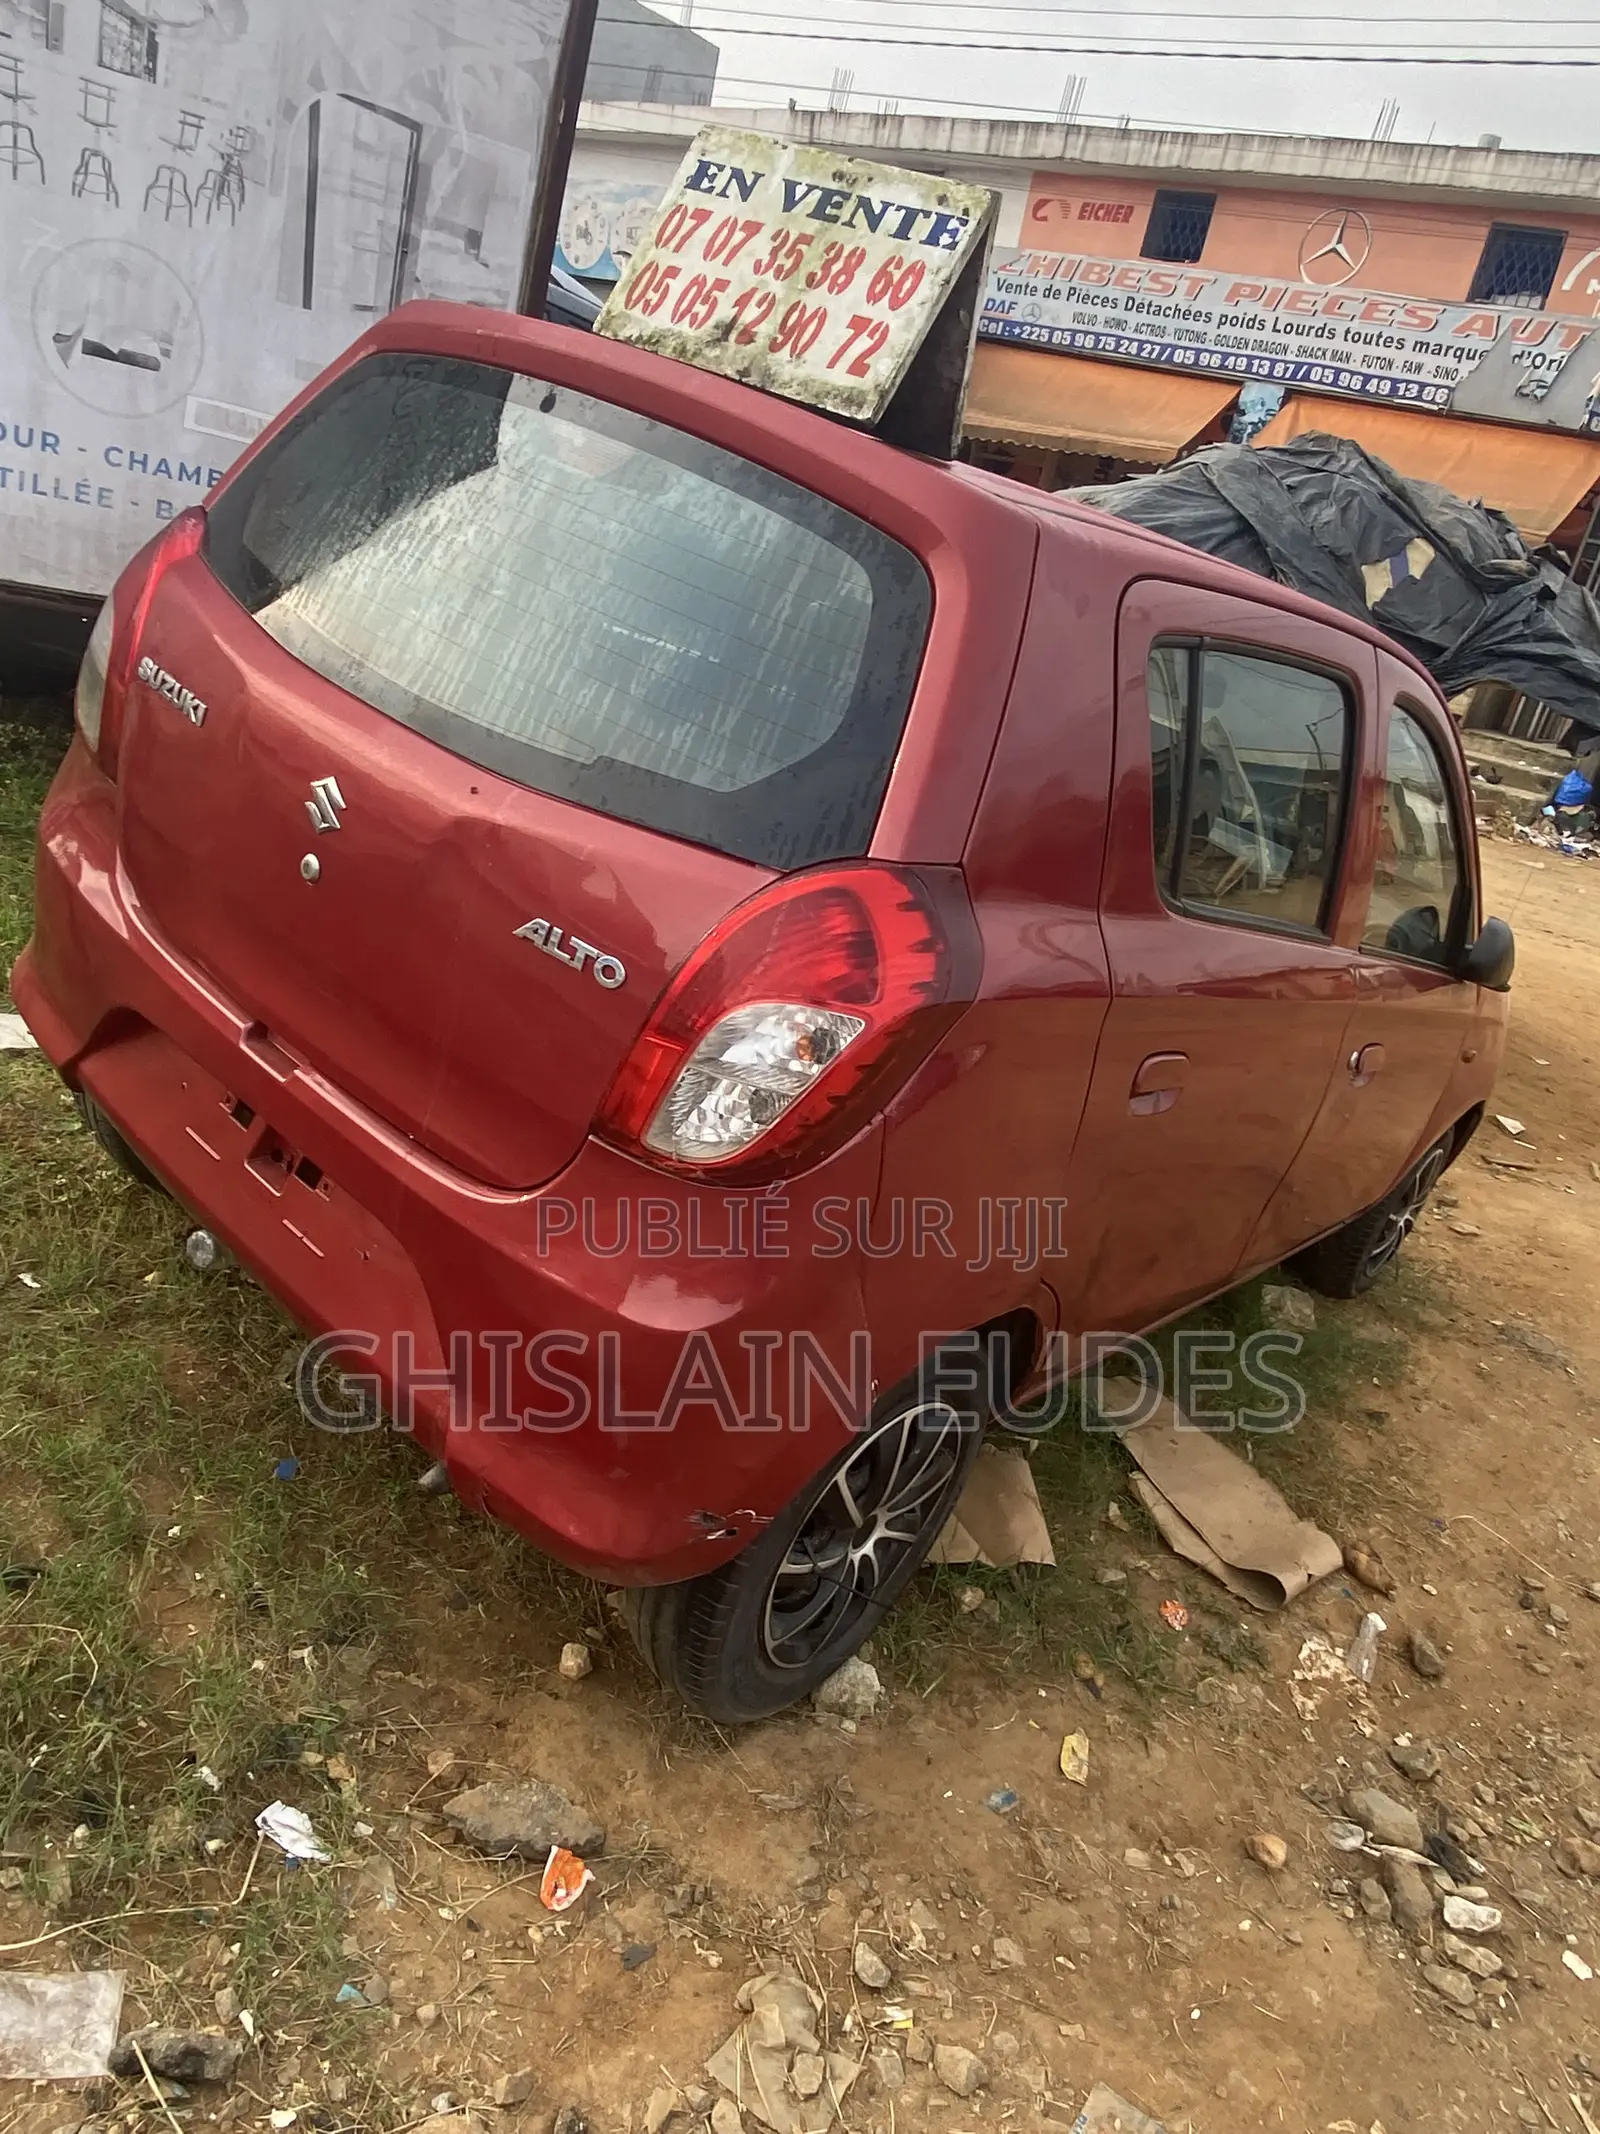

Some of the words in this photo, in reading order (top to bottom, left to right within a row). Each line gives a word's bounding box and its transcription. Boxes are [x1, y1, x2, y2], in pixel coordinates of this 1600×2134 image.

[683, 158, 766, 203] EN
[781, 178, 970, 252] VENTE
[1077, 201, 1135, 225] EICHER
[655, 204, 714, 254] 07
[703, 215, 766, 267] 07
[753, 228, 816, 282] 35
[805, 241, 867, 296] 38
[866, 255, 927, 312] 60
[624, 260, 684, 317] 05
[671, 273, 732, 331] 05
[730, 286, 777, 346] 12
[768, 299, 828, 359] 90
[826, 314, 891, 379] 72
[984, 298, 1019, 315] DAF
[996, 277, 1038, 297] Vente
[1042, 283, 1062, 300] de
[1066, 286, 1119, 311] Pièces
[1124, 295, 1213, 324] Détachées
[1217, 312, 1267, 332] poids
[1271, 317, 1337, 340] Lourds
[1343, 326, 1407, 350] toutes
[1223, 281, 1446, 333] PIECES
[1052, 331, 1072, 345] 05
[1074, 333, 1096, 348] 96
[1098, 336, 1117, 351] 75
[1118, 339, 1139, 355] 24
[1140, 344, 1161, 359] 27
[1173, 348, 1196, 364] 05
[1224, 356, 1248, 371] 49
[1251, 359, 1271, 375] 13
[1309, 366, 1336, 384] 05
[1365, 376, 1392, 395] 49
[1395, 381, 1420, 398] 13
[1072, 311, 1098, 327] VOLVO
[1132, 322, 1167, 339] ACTROS
[1173, 328, 1208, 344] YUTONG
[1214, 334, 1250, 350] GOLDEN
[1251, 340, 1290, 357] DRAGON
[1295, 345, 1328, 361] SHACK
[1329, 349, 1352, 365] MAN
[1360, 354, 1395, 371] FUTON
[1401, 360, 1424, 375] FAW
[1433, 366, 1459, 381] SINO
[0, 466, 114, 509] TILLÉE
[138, 656, 208, 727] SUZUKI
[512, 917, 626, 989] ALTO
